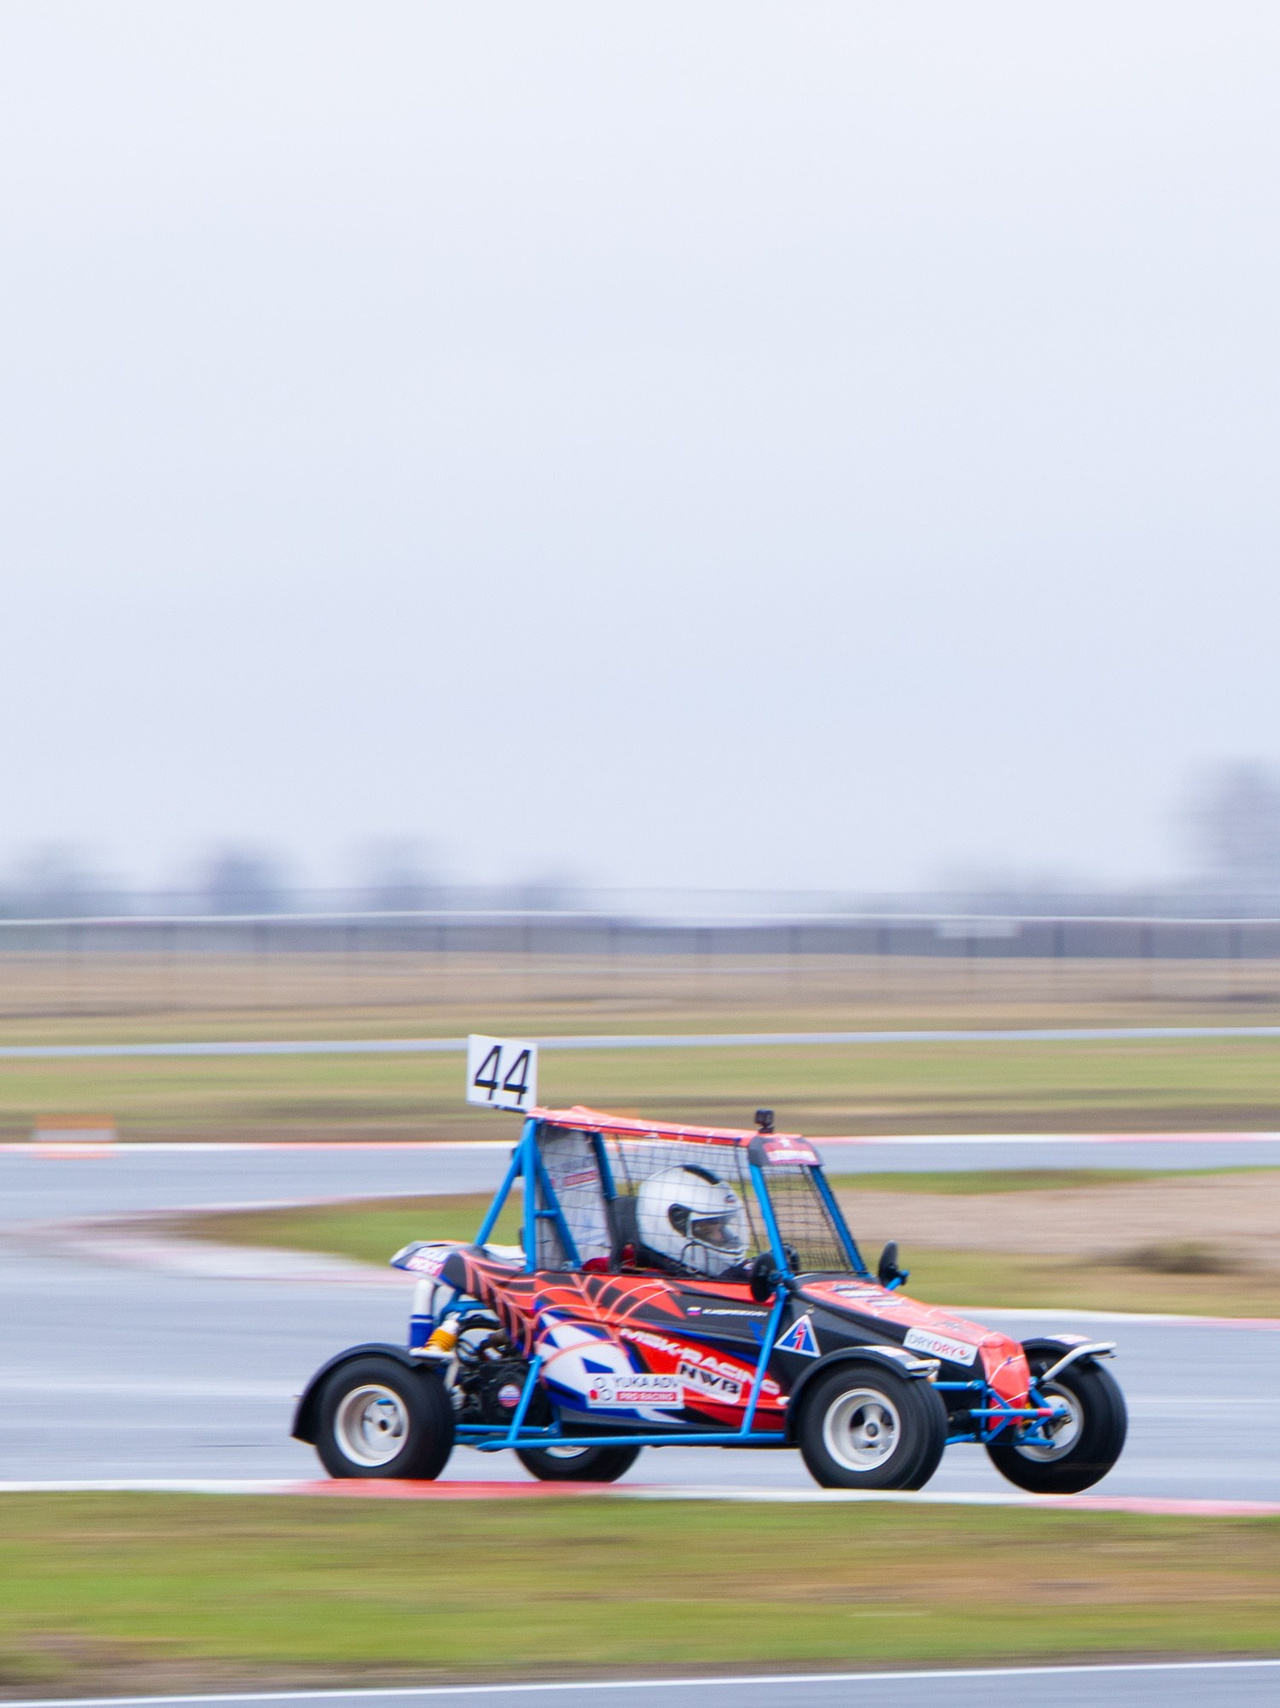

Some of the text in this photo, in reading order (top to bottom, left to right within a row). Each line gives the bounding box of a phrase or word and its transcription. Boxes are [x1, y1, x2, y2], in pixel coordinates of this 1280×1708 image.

[474, 1045, 531, 1105] 44
[680, 1362, 739, 1395] NWB
[619, 1392, 676, 1401] PRO RACING
